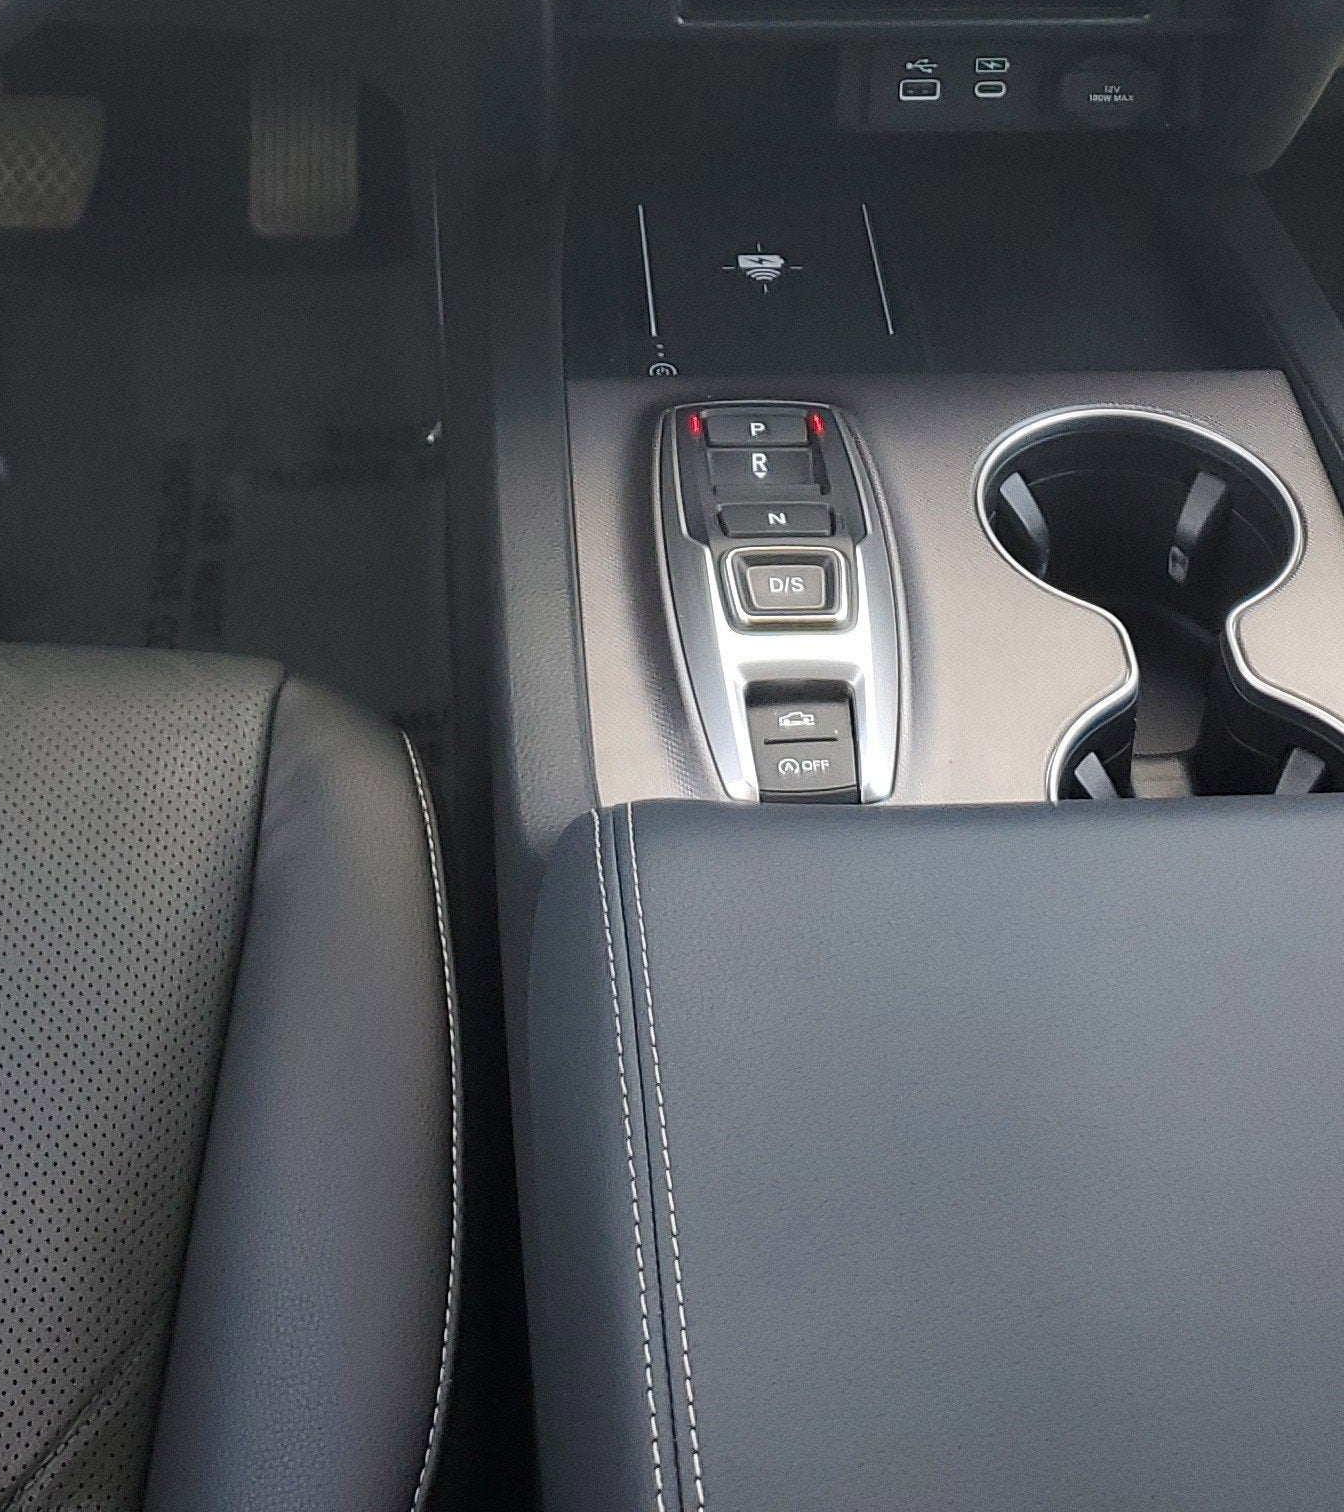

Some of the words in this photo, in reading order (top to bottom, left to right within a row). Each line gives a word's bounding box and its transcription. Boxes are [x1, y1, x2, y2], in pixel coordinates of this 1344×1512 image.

[750, 422, 765, 437] P
[752, 453, 767, 471] R
[768, 512, 787, 525] N
[769, 576, 805, 592] D/S
[801, 759, 830, 772] OFF
